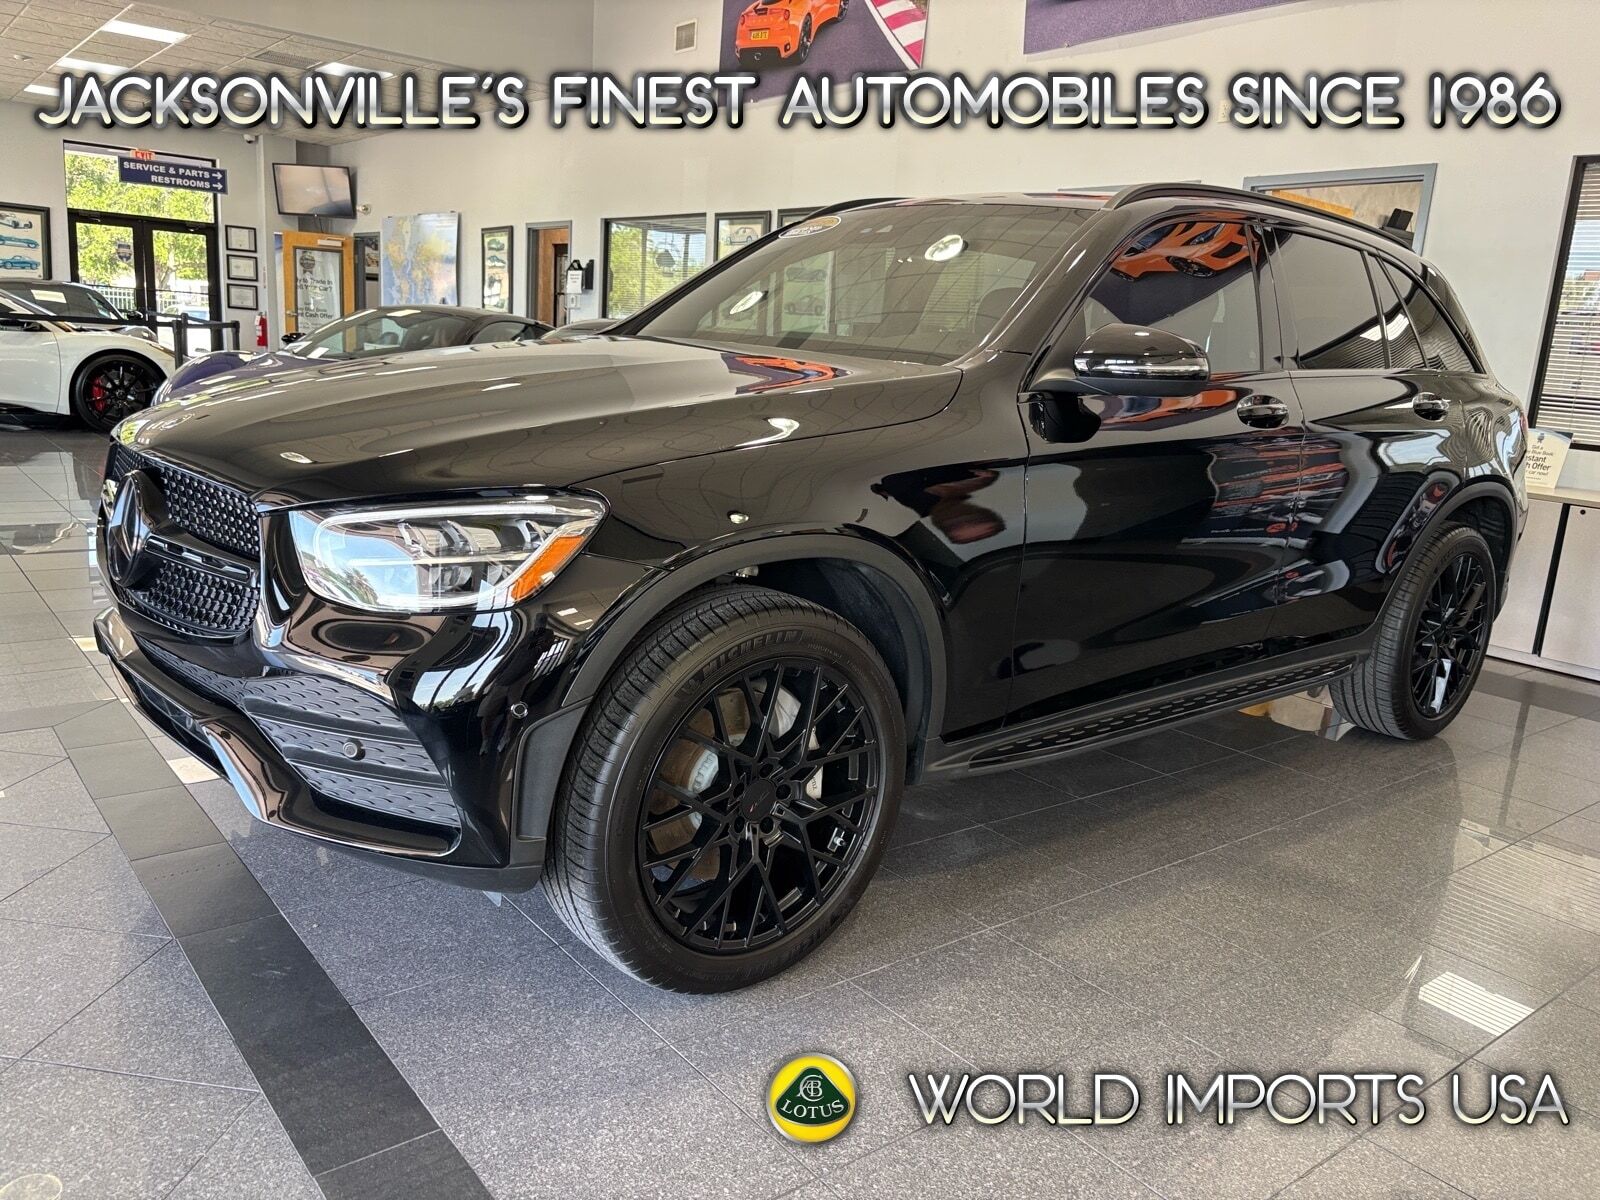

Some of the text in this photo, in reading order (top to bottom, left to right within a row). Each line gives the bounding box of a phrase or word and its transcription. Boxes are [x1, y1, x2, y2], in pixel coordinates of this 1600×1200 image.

[135, 151, 153, 160] EXIT
[123, 161, 210, 179] SERVICE & PARTS
[151, 175, 211, 189] RESTROOMS
[1532, 462, 1551, 471] Offer
[703, 630, 799, 678] MICHELIN
